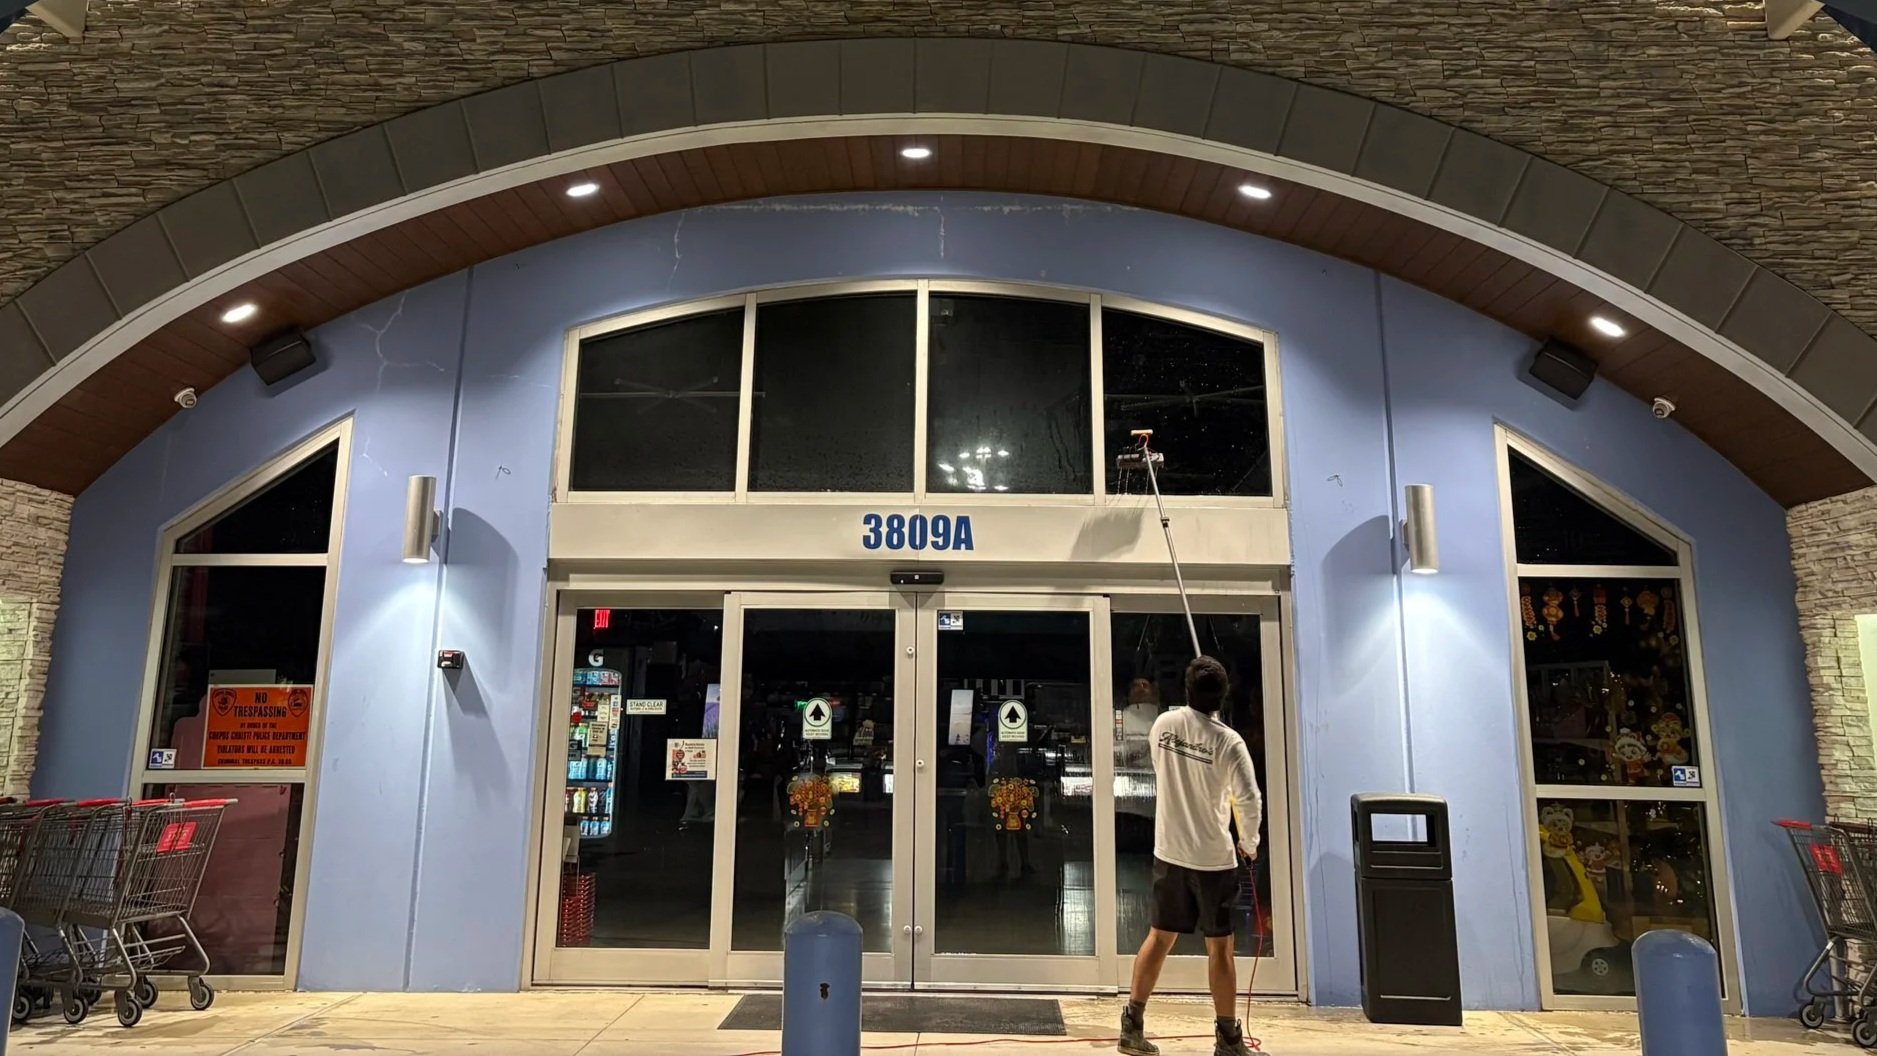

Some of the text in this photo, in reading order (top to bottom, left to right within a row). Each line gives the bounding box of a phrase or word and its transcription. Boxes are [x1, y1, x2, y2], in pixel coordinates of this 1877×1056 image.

[862, 513, 974, 551] 3809A
[594, 609, 611, 628] EXIT
[588, 648, 604, 667] G
[255, 692, 268, 703] NO
[234, 706, 287, 717] TRESPASSING
[209, 731, 230, 740] CORPUS
[253, 731, 271, 740] POLICE
[272, 732, 305, 740] DEPARTMENT
[217, 745, 296, 754] VIOLATORS WILL BE ARRESTED
